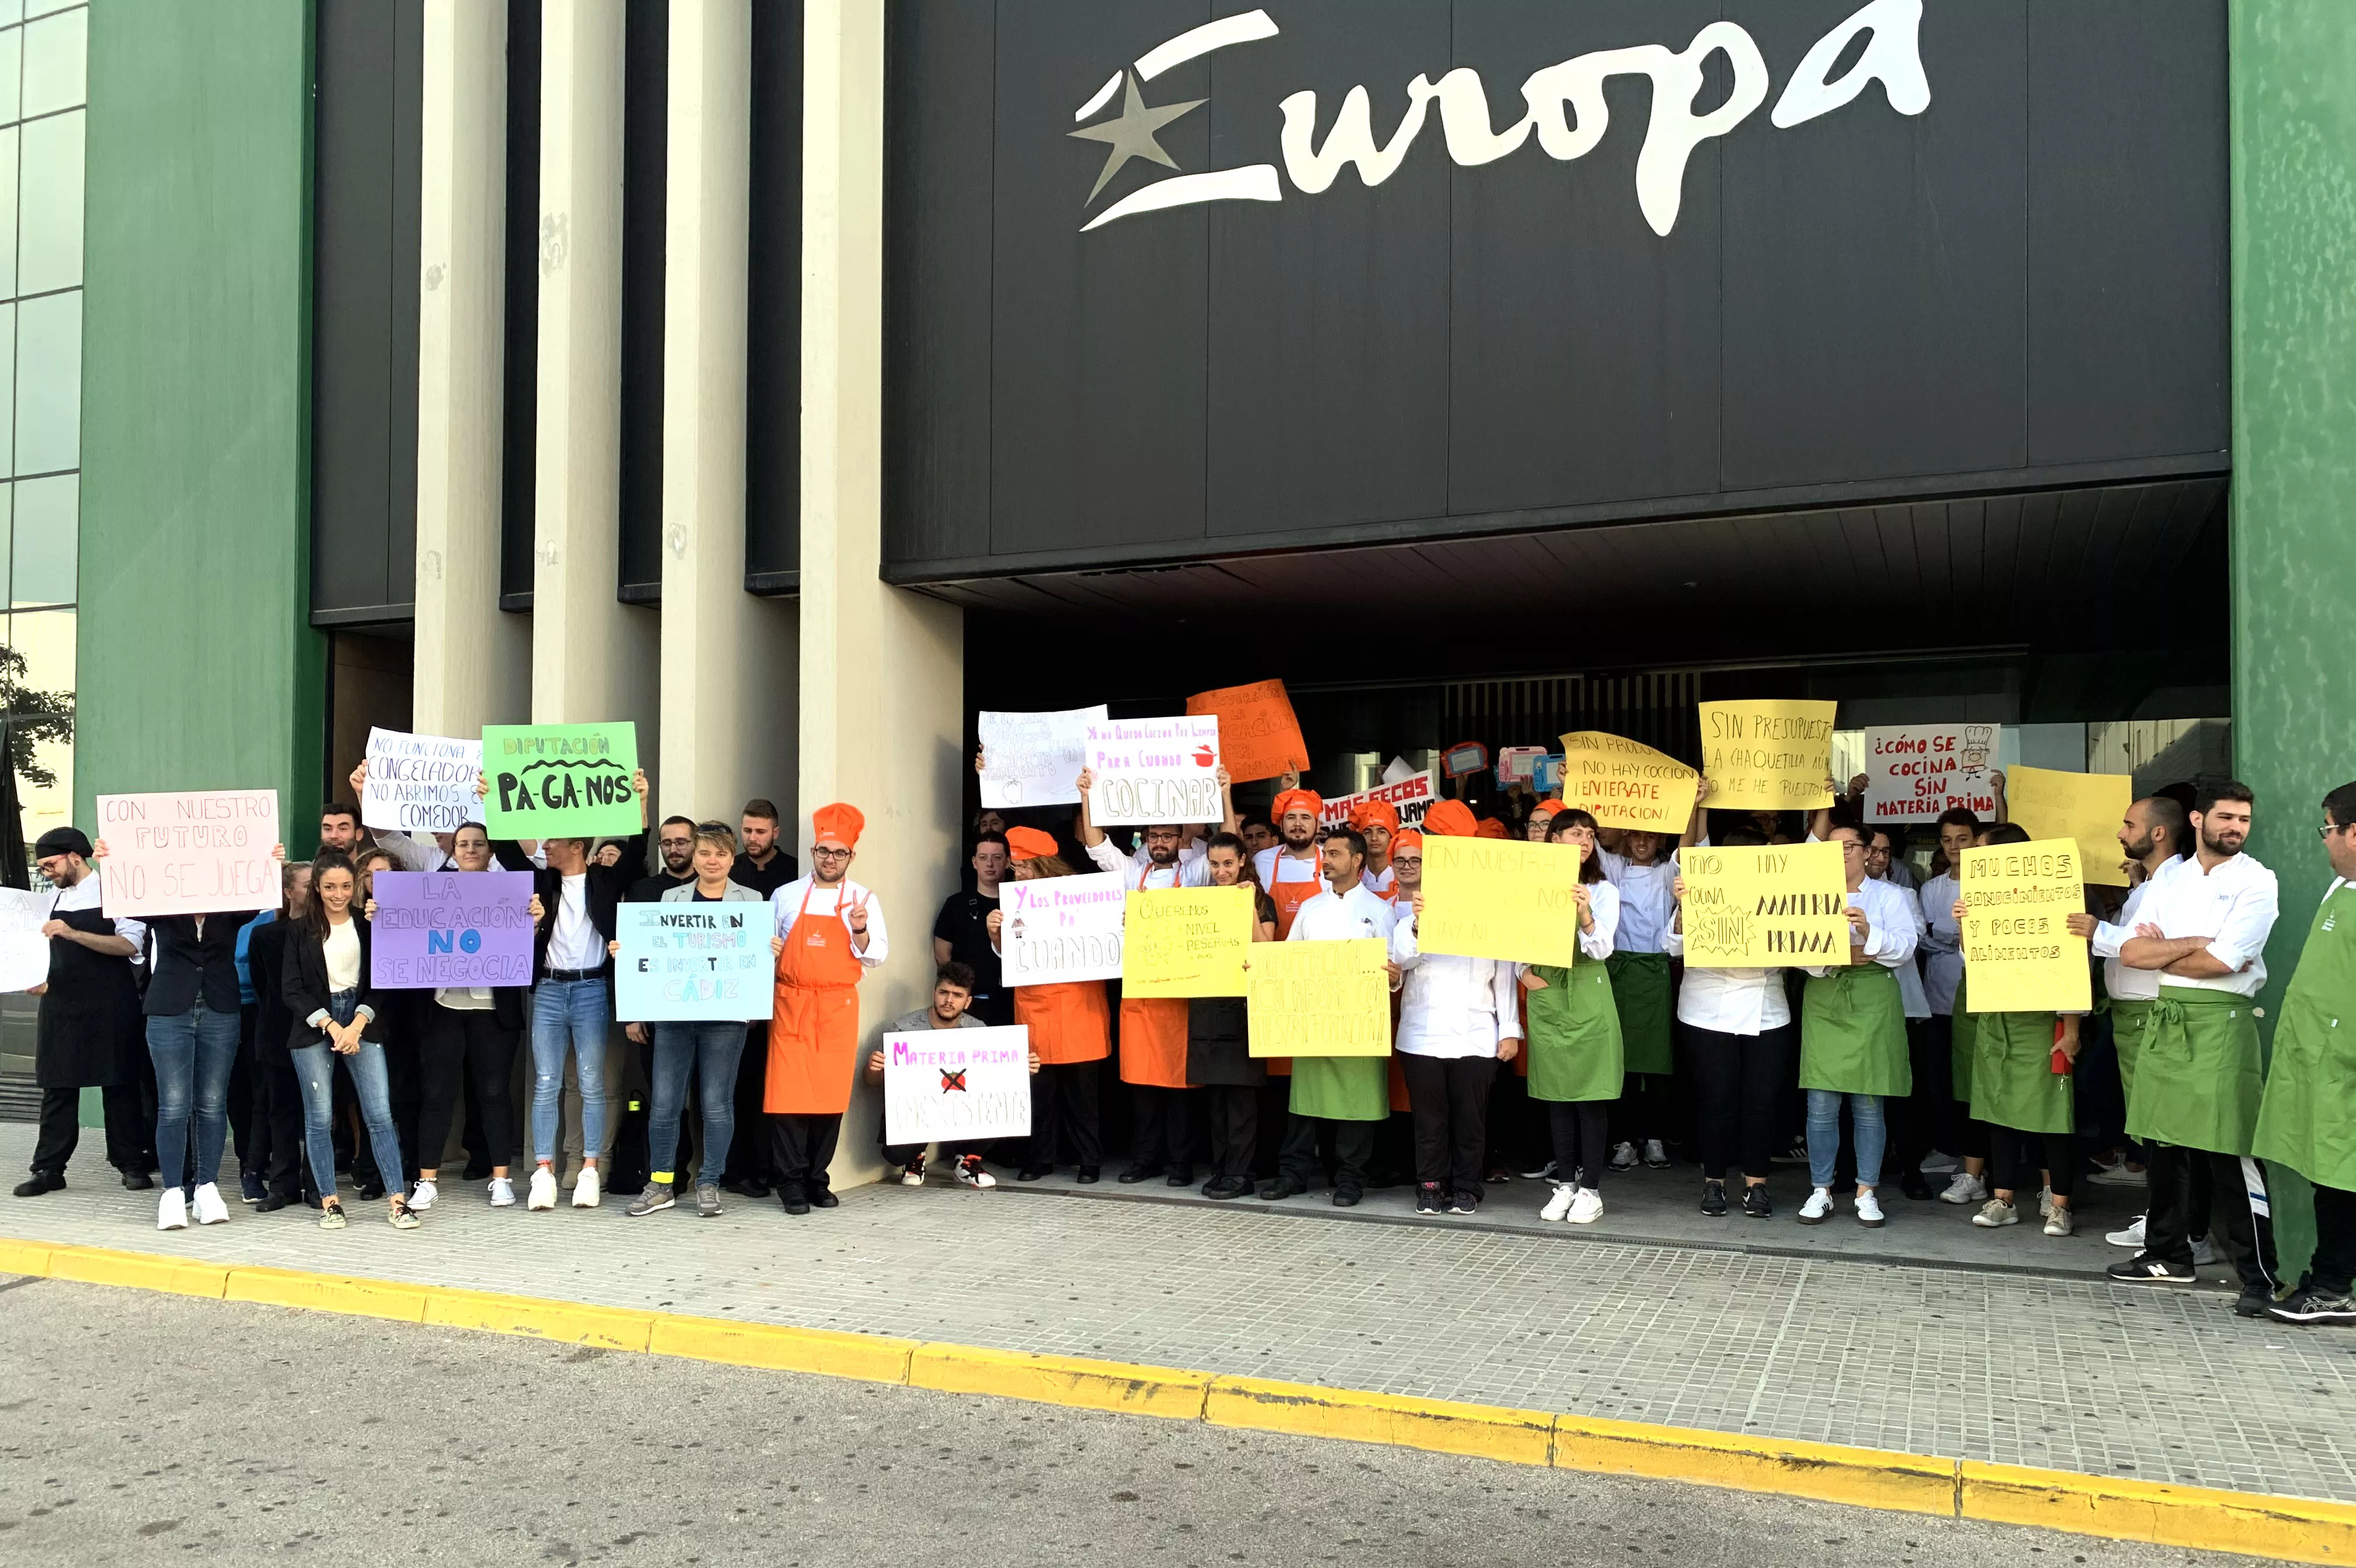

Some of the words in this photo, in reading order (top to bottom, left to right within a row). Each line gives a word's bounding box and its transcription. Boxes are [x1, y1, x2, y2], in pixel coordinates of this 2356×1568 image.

[1070, 0, 1932, 235] Europa
[1711, 711, 1743, 741] SIN
[1753, 714, 1833, 744] PRESUPUESTO
[374, 737, 393, 753] NO
[399, 740, 465, 759] FUNCIONA
[503, 732, 609, 755] DIPUTACIÓN
[1569, 735, 1599, 750] SIN
[1875, 734, 1927, 755] ¿CÓMO
[1932, 736, 1956, 752] SE
[368, 755, 480, 783] CONGELADOR
[1096, 751, 1131, 769] PARA
[1138, 750, 1182, 768] CUANDO
[1583, 760, 1606, 775] NO
[1612, 762, 1640, 779] HAY
[1703, 746, 1723, 769] LA
[1730, 747, 1805, 772] CHAQUETILLA
[1889, 756, 1957, 776] COCINA
[369, 783, 389, 802] NO
[394, 783, 459, 803] ABRIMOS
[1728, 778, 1746, 793] ME
[1753, 778, 1769, 794] HE
[1914, 776, 1948, 797] SIN
[106, 800, 145, 823] CON
[177, 796, 270, 820] NUESTRO
[1102, 778, 1216, 818] COCINAR
[1876, 797, 1940, 816] MATERIA
[1946, 792, 1994, 813] PRIMA
[400, 804, 469, 828] COMEDOR
[136, 825, 248, 849] FUTURO
[1429, 845, 1460, 869] EN
[1471, 848, 1556, 873] NUESTRA
[1758, 854, 1788, 873] HAY
[1970, 855, 2073, 879] MUCHOS
[110, 862, 145, 900] NO
[163, 863, 198, 897] SE
[207, 857, 276, 897] JUEGA
[422, 877, 462, 900] LA
[1014, 886, 1028, 910] Y
[1030, 893, 1050, 908] LOS
[1054, 889, 1122, 907] PROVEEDORES
[1537, 887, 1568, 910] NO
[1755, 893, 1843, 916] MATERIA
[1964, 884, 2081, 907] CONOCIMIENTOS
[381, 898, 526, 929] EDUCACIÓN
[639, 910, 717, 929] INVERTIR
[722, 913, 743, 928] EN
[1139, 897, 1209, 920] QUEREMOS
[1186, 922, 1220, 935] NIVEL
[1697, 917, 1744, 945] SIN
[1969, 920, 1980, 938] Y
[1991, 917, 2049, 935] POCOS
[428, 928, 481, 955] NO
[652, 935, 667, 948] EL
[673, 931, 747, 949] TURISMO
[1187, 937, 1239, 951] RESERVAS
[1767, 929, 1836, 954] PRIMA
[637, 957, 660, 973] ES
[667, 956, 733, 973] INVERTIR
[739, 954, 757, 969] EN
[1970, 945, 2060, 962] ALIMENTOS
[374, 957, 409, 984] SE
[417, 955, 531, 983] NEGOCIA
[663, 973, 739, 1002] CÁDIZ
[893, 1042, 966, 1066] MATERIA
[972, 1050, 1019, 1064] PRIMA
